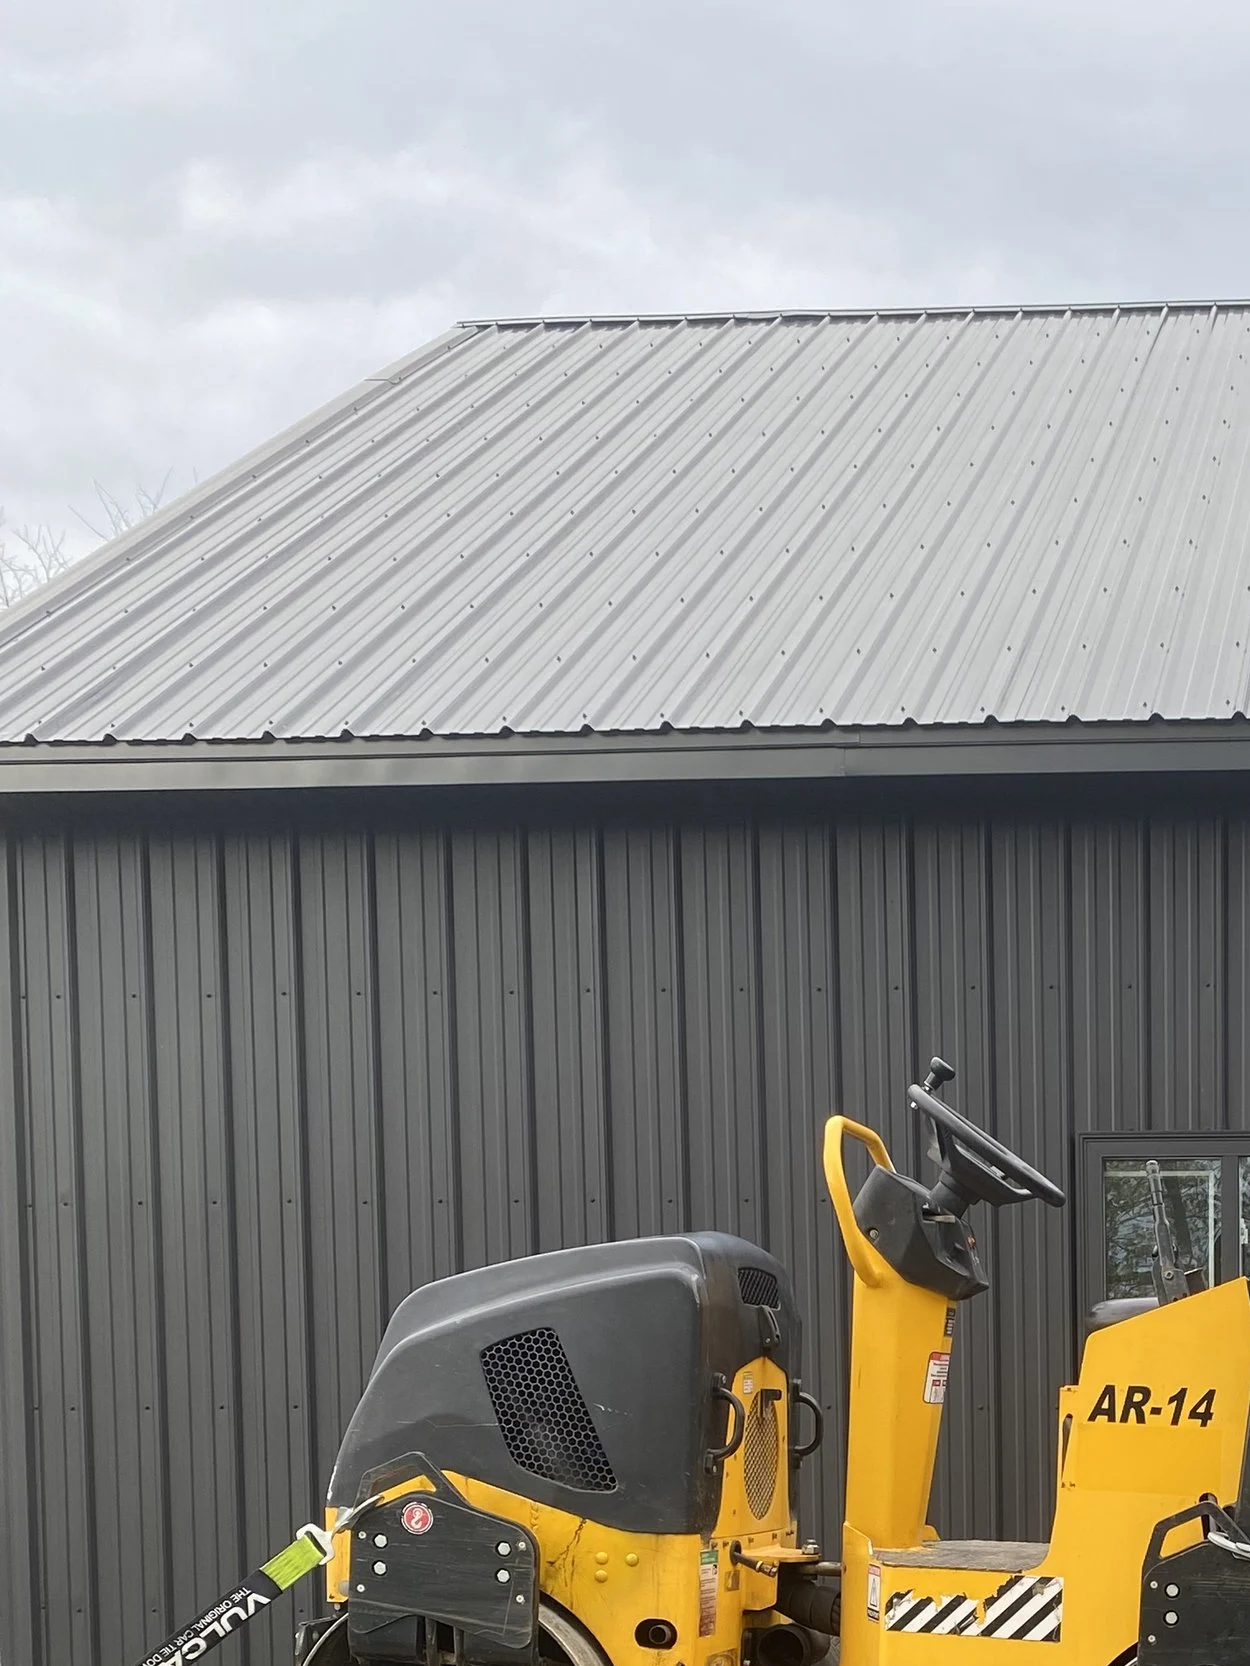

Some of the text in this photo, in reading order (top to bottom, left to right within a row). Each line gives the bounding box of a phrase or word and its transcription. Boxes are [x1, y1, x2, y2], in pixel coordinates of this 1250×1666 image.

[1087, 1384, 1217, 1428] AR-14
[230, 1586, 252, 1604] THE
[193, 1600, 232, 1632] ORIGINAL
[175, 1629, 194, 1647] CAR
[160, 1643, 177, 1658] TIE
